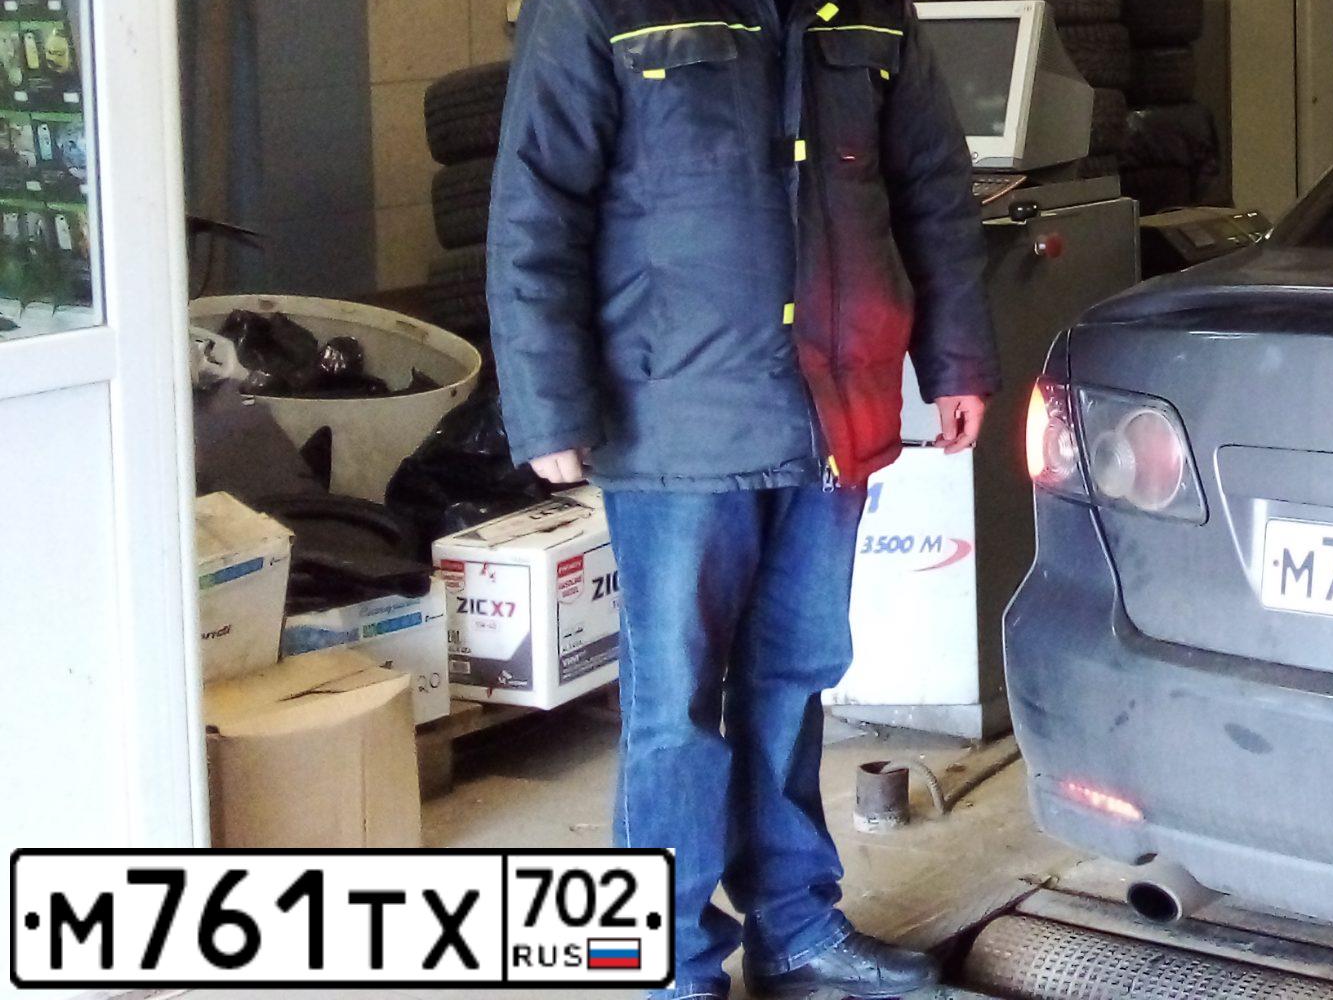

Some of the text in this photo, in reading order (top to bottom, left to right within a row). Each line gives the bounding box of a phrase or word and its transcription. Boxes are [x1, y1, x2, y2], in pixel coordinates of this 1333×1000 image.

[860, 535, 915, 554] 3500
[456, 596, 516, 618] ZIC X7
